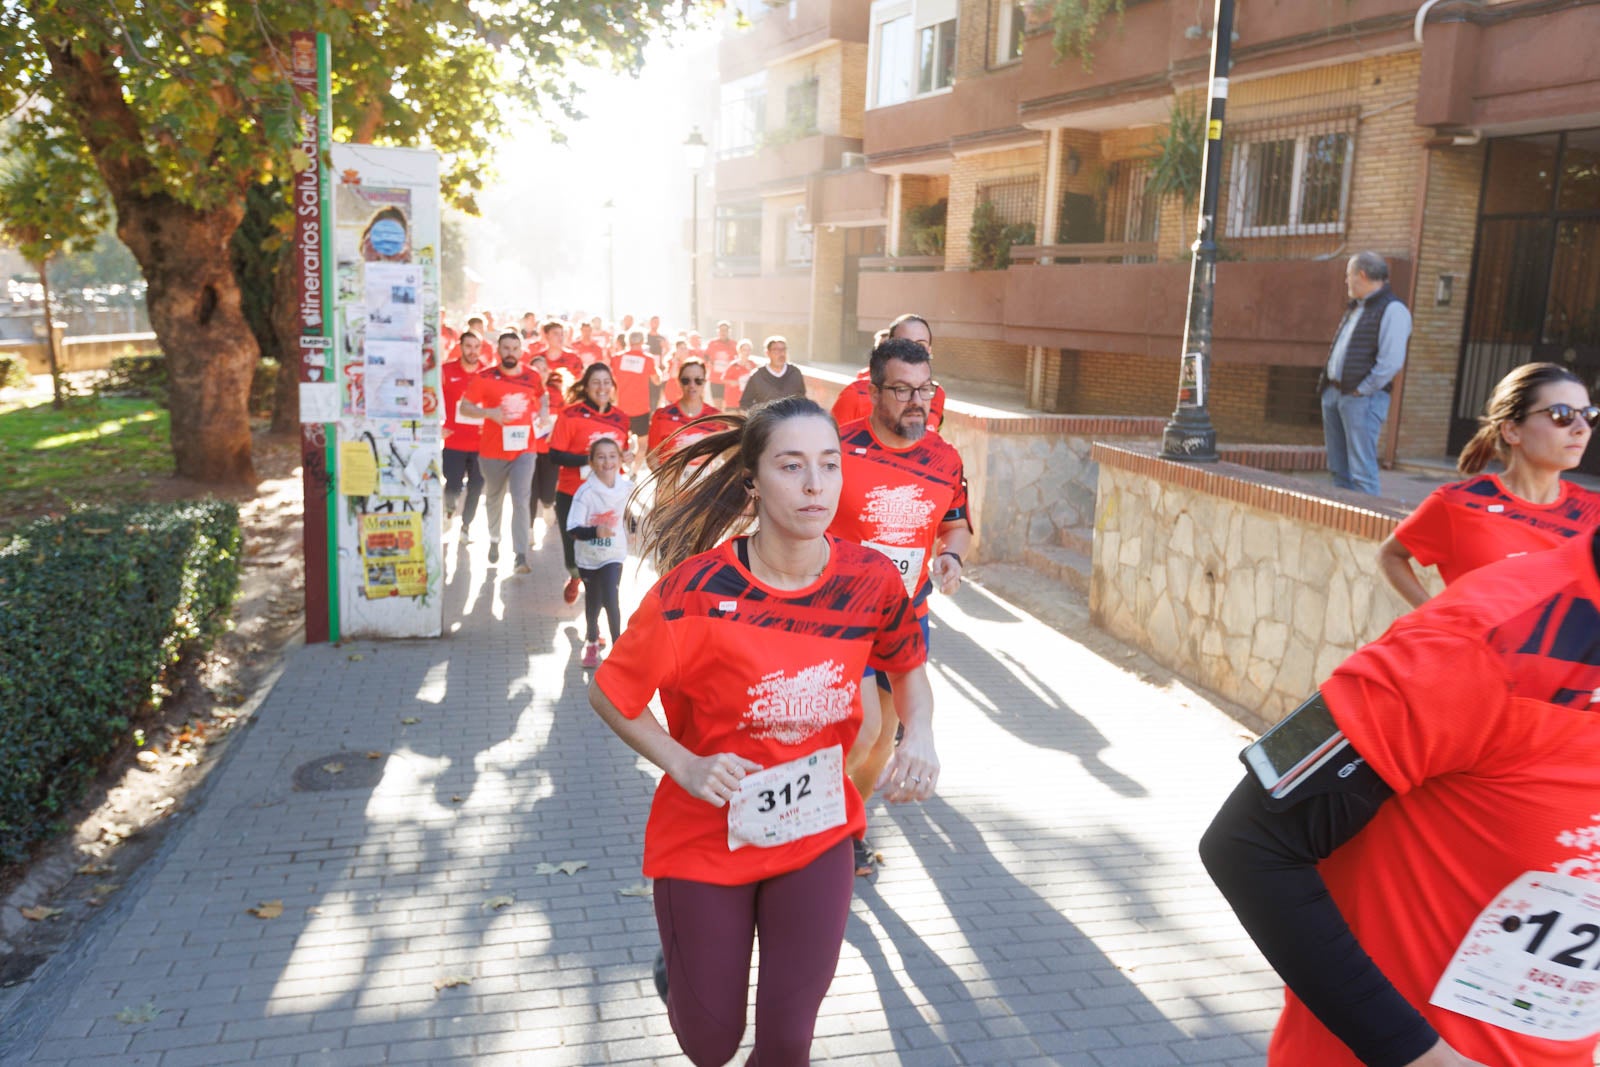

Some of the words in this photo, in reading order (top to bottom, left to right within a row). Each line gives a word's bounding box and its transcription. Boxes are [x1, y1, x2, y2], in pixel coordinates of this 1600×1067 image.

[868, 500, 929, 515] carrera
[892, 559, 909, 575] 9
[751, 689, 850, 719] carrera
[757, 773, 812, 813] 312
[1524, 910, 1600, 970] 12
